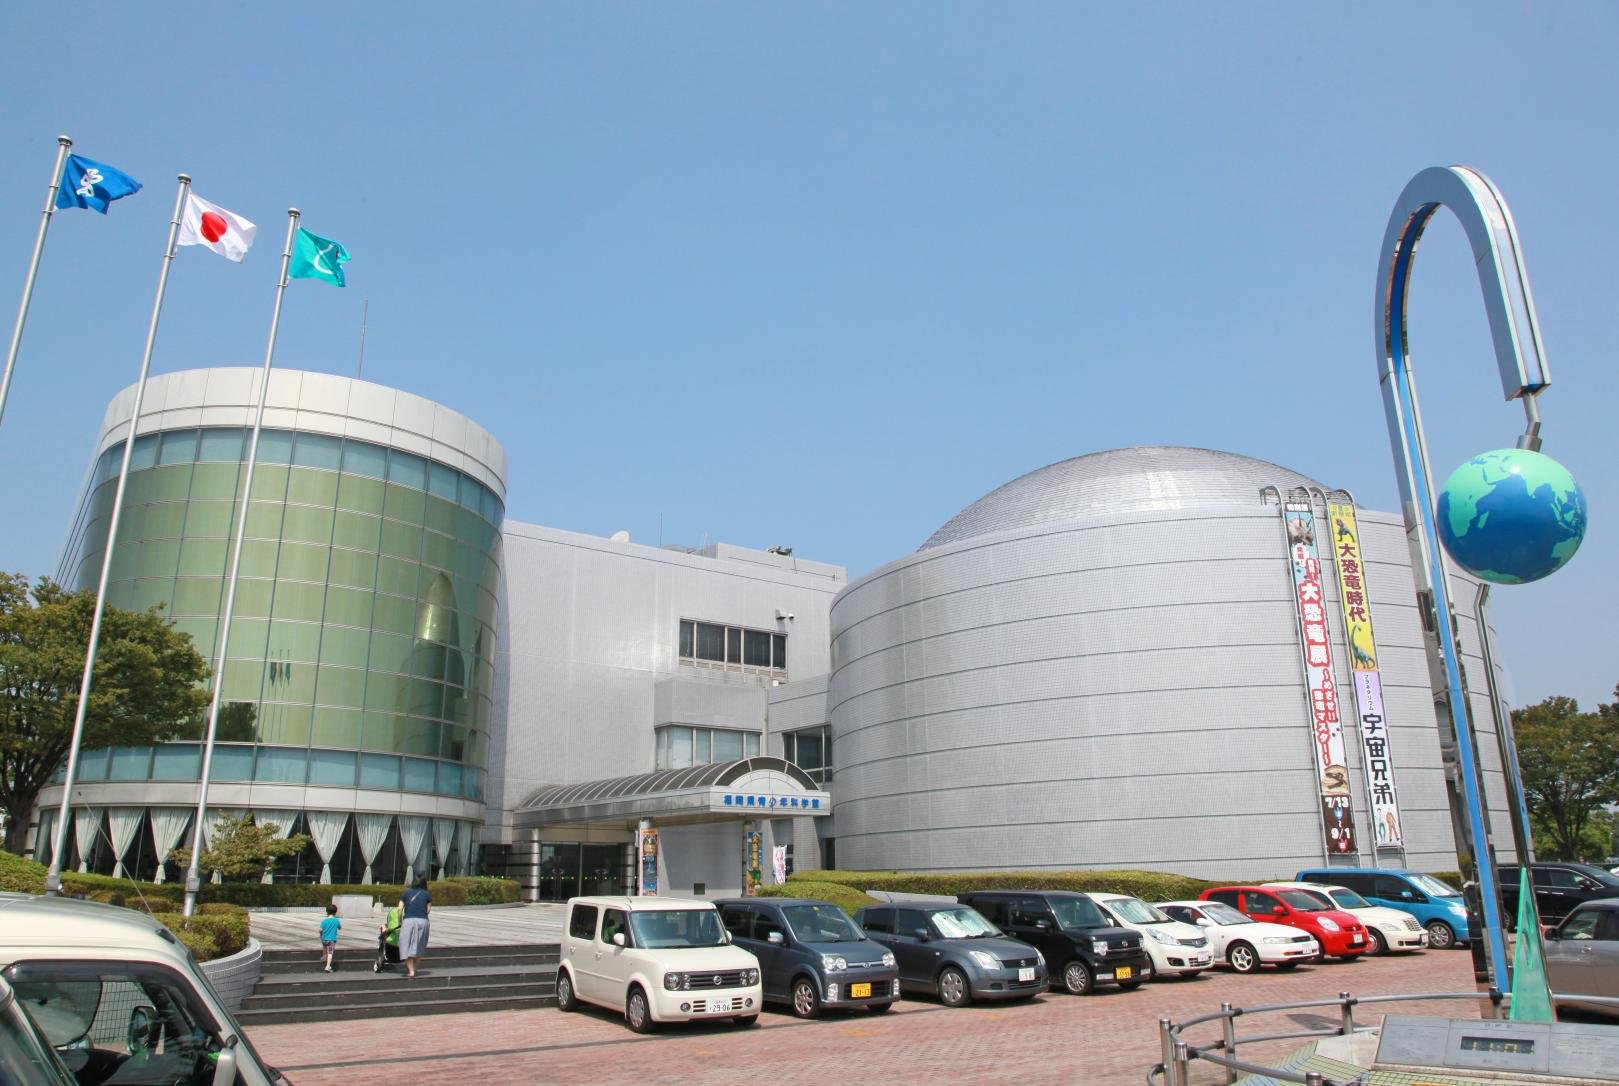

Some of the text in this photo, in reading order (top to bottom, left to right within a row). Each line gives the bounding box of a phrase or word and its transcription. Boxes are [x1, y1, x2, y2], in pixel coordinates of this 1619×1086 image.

[1338, 543, 1366, 622] 大恐竜時代
[1362, 713, 1394, 805] 宇宙兄弟
[1325, 796, 1349, 809] 7/13
[1330, 827, 1351, 840] 9/1
